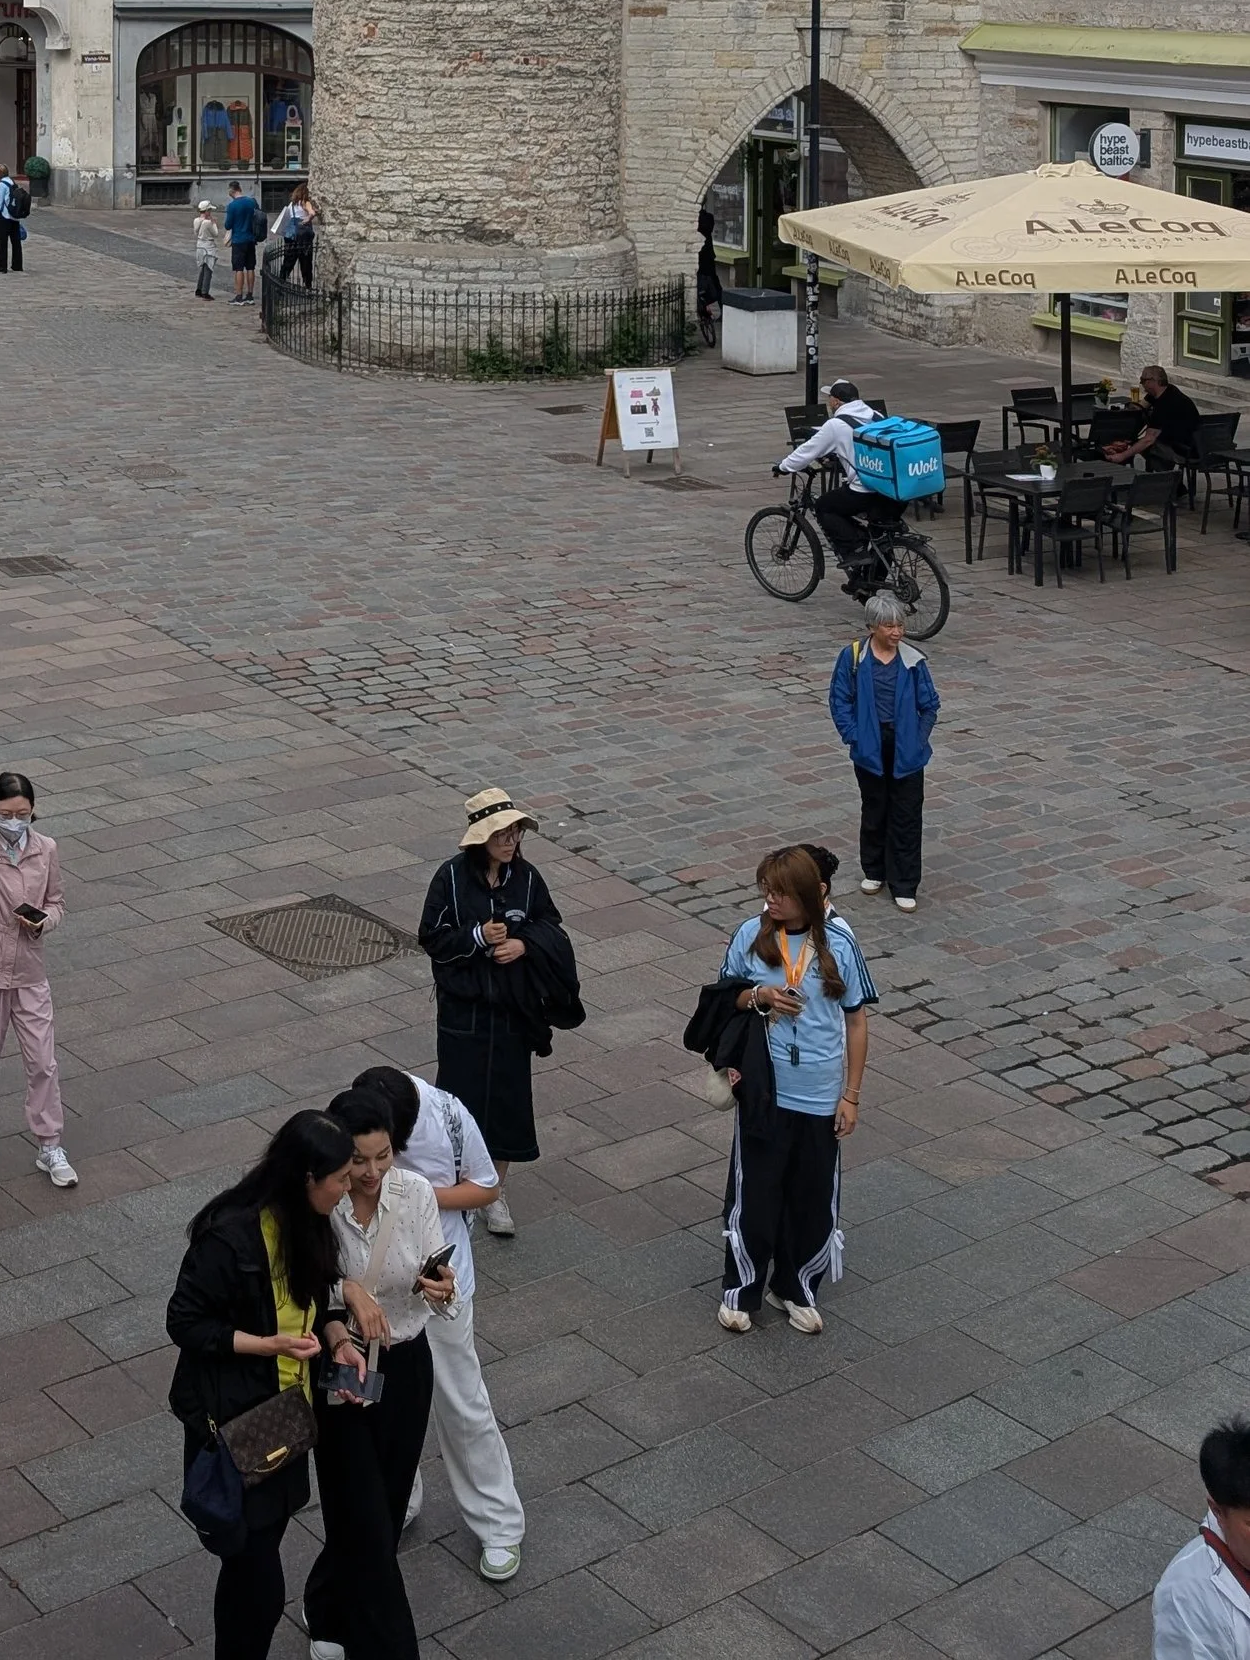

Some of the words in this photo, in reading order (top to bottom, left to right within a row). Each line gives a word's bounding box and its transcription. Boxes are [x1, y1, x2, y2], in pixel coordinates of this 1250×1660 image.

[1100, 133, 1127, 146] hype
[1187, 133, 1250, 150] hypebeastb
[1100, 144, 1129, 155] beast
[1100, 155, 1134, 166] baltics
[859, 453, 884, 473] Wolt
[908, 457, 939, 477] Wolt
